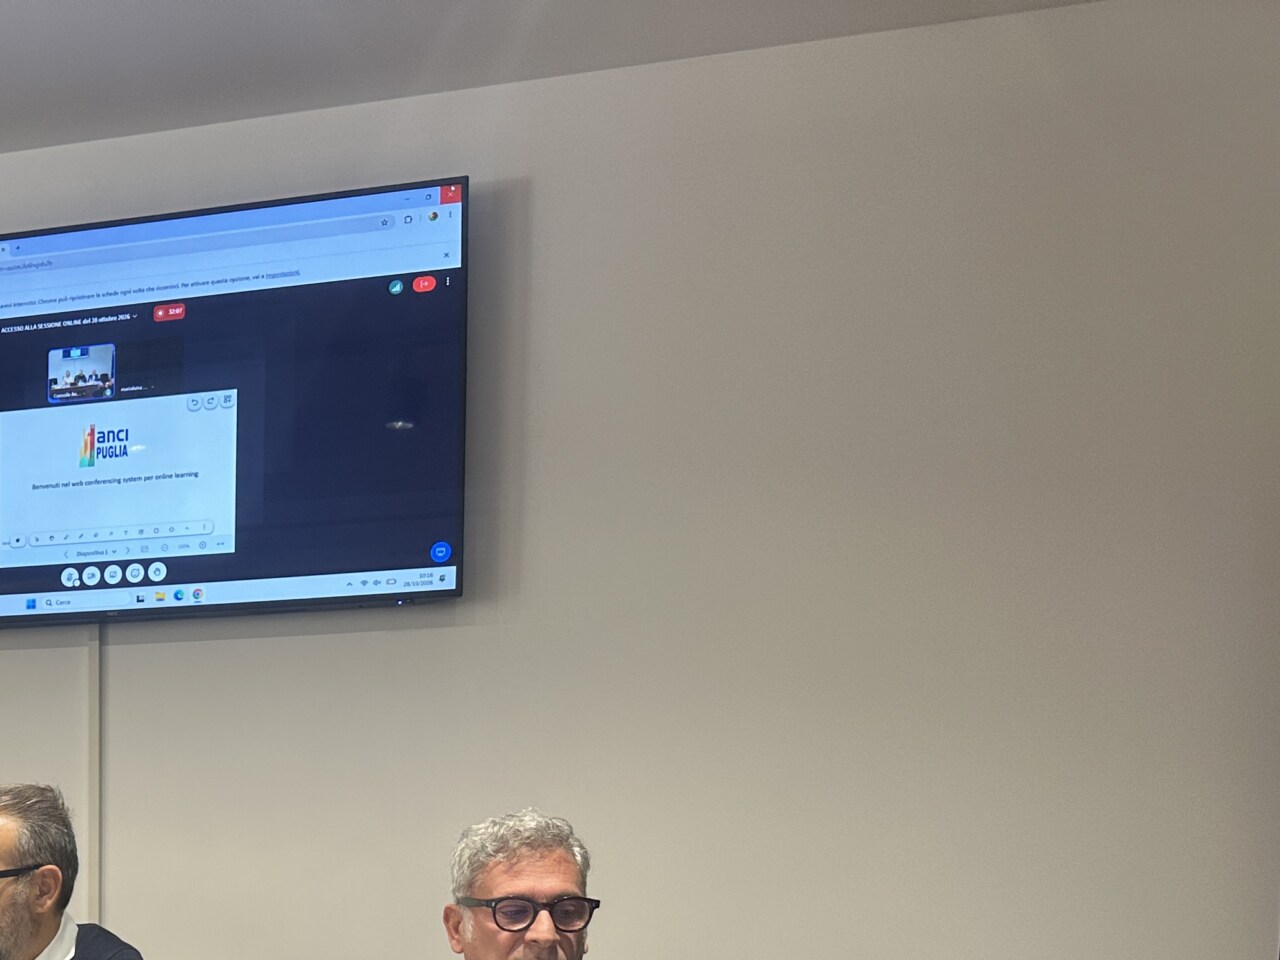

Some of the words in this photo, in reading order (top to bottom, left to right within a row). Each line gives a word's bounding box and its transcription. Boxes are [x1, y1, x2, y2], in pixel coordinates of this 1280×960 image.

[0, 326, 24, 334] ACCESSO
[38, 321, 62, 330] SESSIONE
[62, 318, 81, 327] ONLINE
[96, 428, 129, 444] anci
[96, 444, 128, 460] PUGLIA
[84, 477, 121, 486] conferencing
[122, 475, 142, 484] system
[144, 474, 154, 482] per
[155, 472, 173, 480] online
[174, 471, 198, 479] learning
